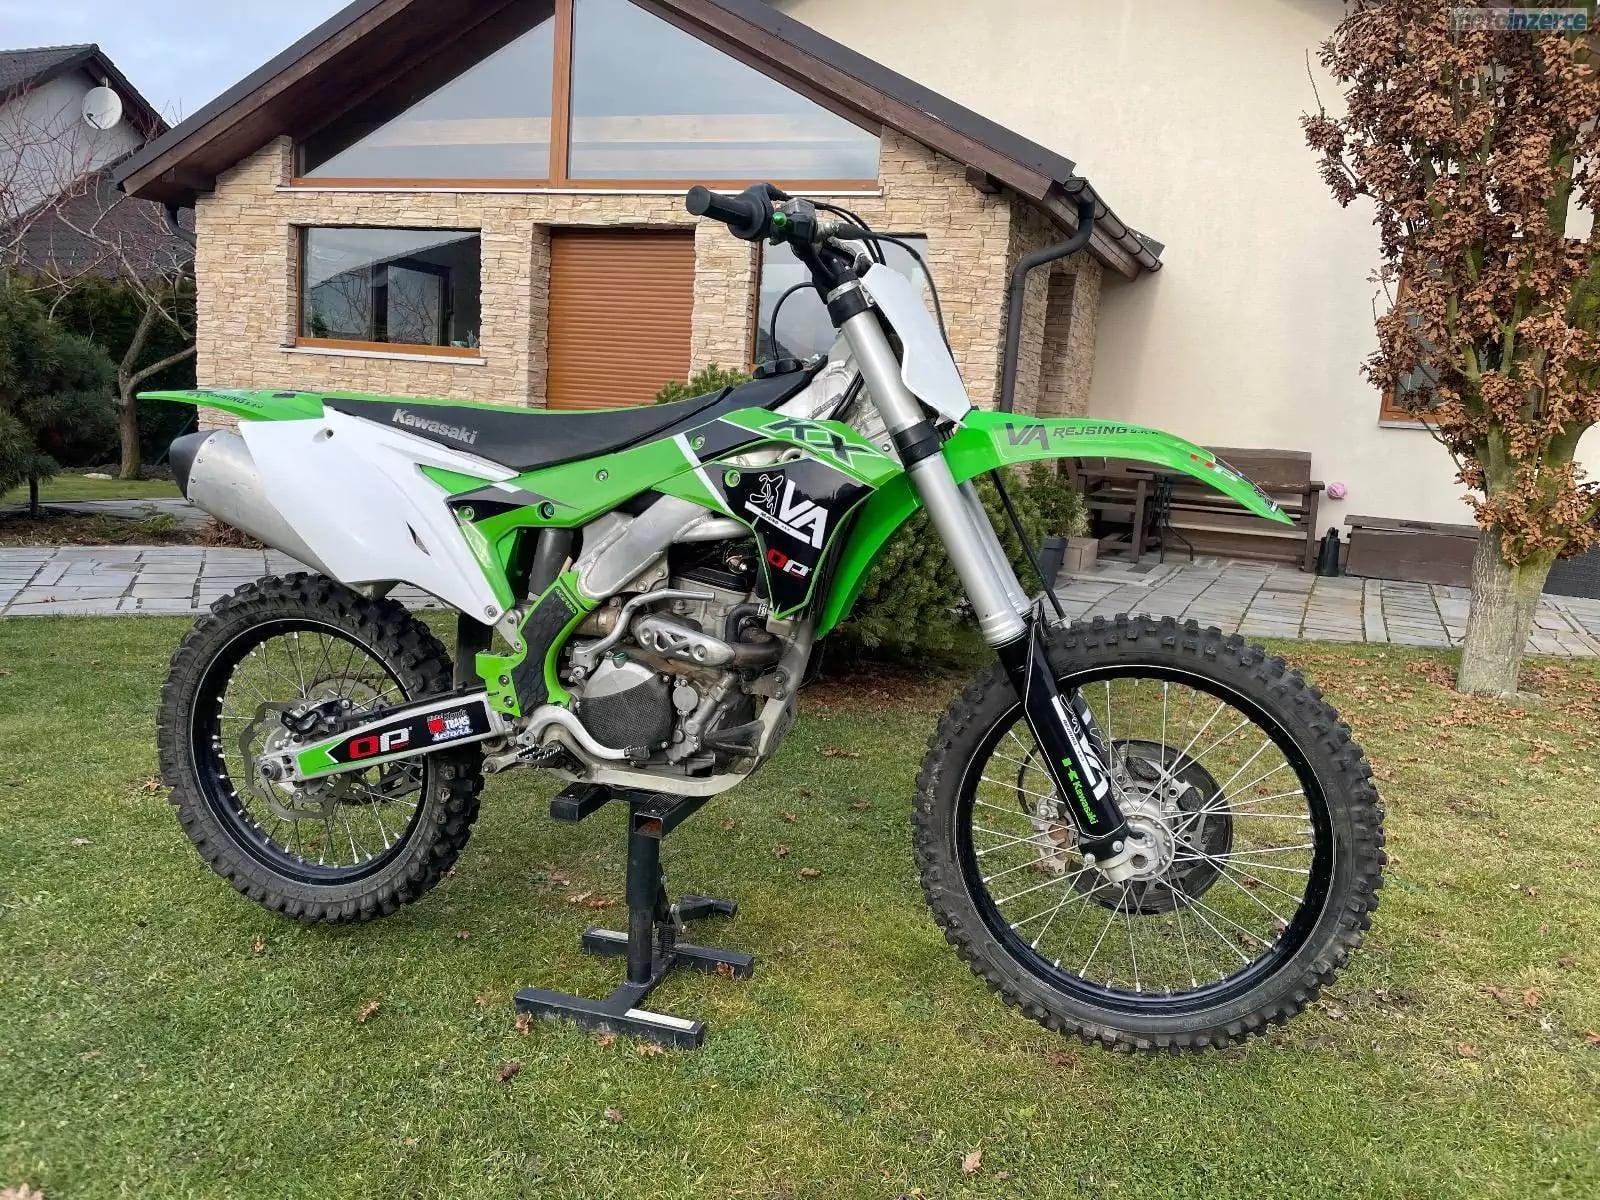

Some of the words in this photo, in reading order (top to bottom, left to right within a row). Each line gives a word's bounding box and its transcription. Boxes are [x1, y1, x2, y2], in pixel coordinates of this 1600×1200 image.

[392, 408, 478, 445] Kawasaki
[1005, 423, 1050, 450] VA
[1053, 426, 1127, 438] REJSING
[778, 478, 829, 550] VA
[1072, 780, 1099, 825] Kawasaki
